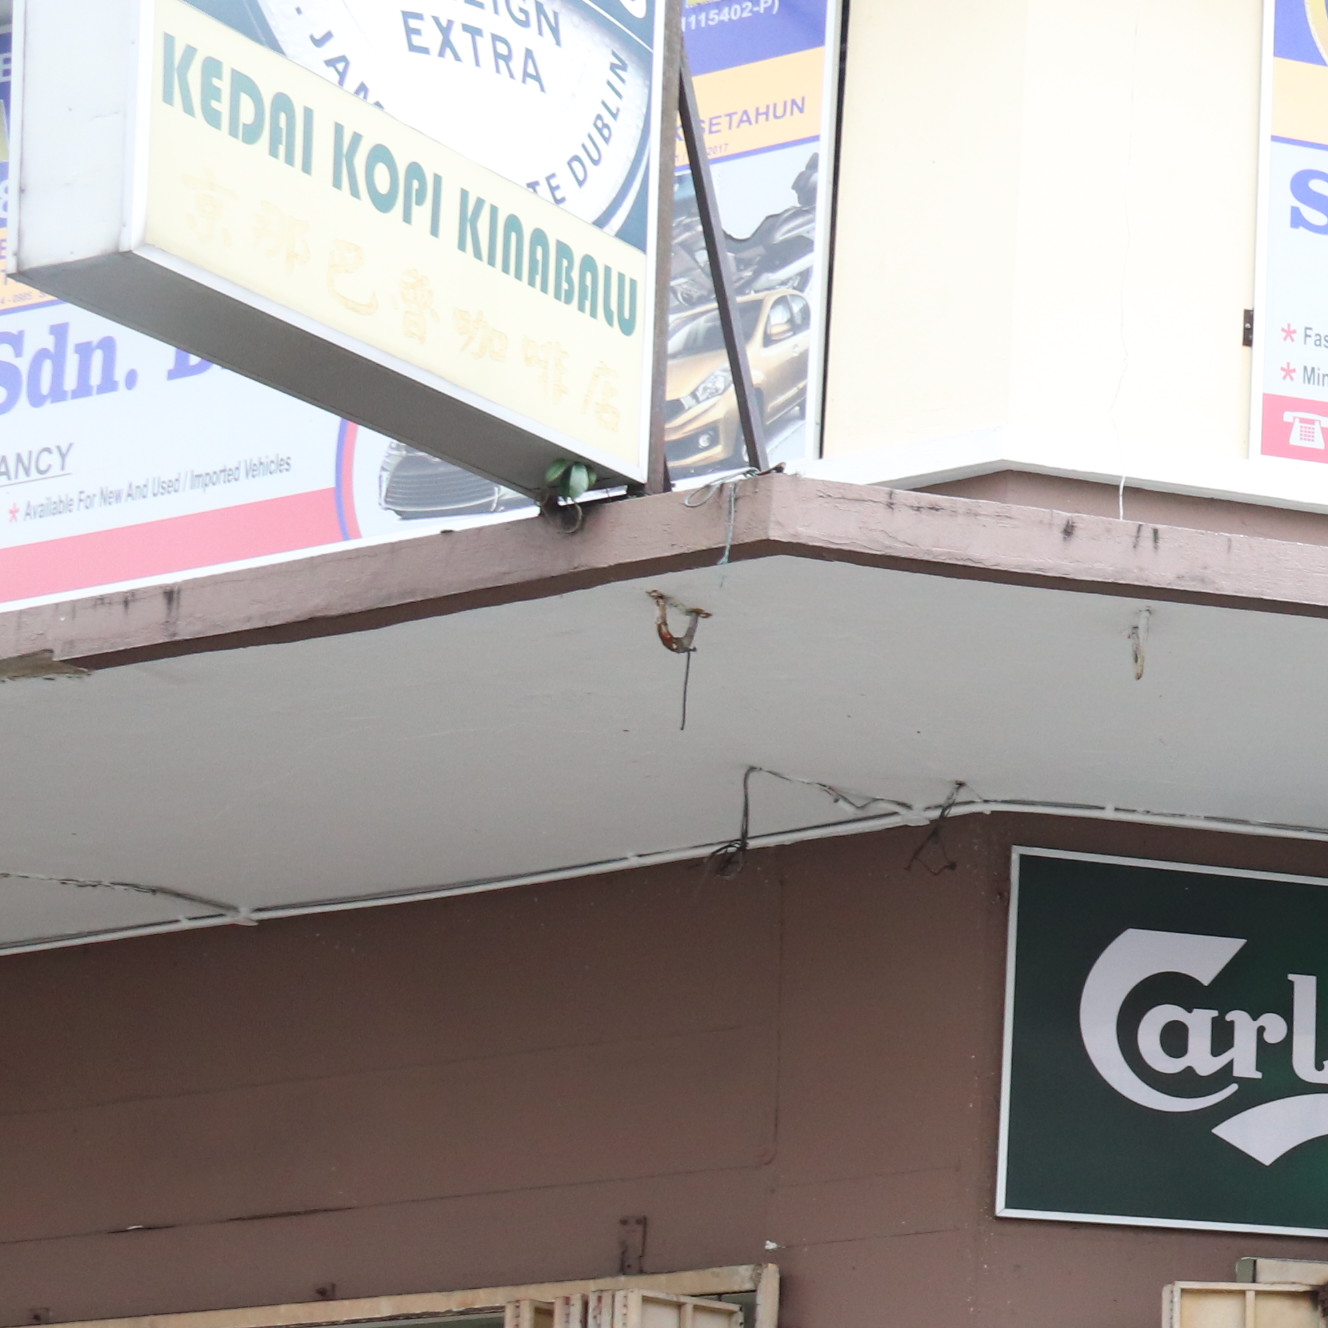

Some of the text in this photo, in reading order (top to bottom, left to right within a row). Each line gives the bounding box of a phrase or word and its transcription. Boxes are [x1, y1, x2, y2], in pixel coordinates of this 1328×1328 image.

[401, 10, 547, 94] EXTRA
[566, 50, 630, 188] DUBLIN
[162, 31, 314, 177] KEDAI
[332, 121, 443, 239] KOPI
[457, 187, 639, 338] KINABALU
[23, 453, 292, 521] Available For New And Used Imported Vehicles
